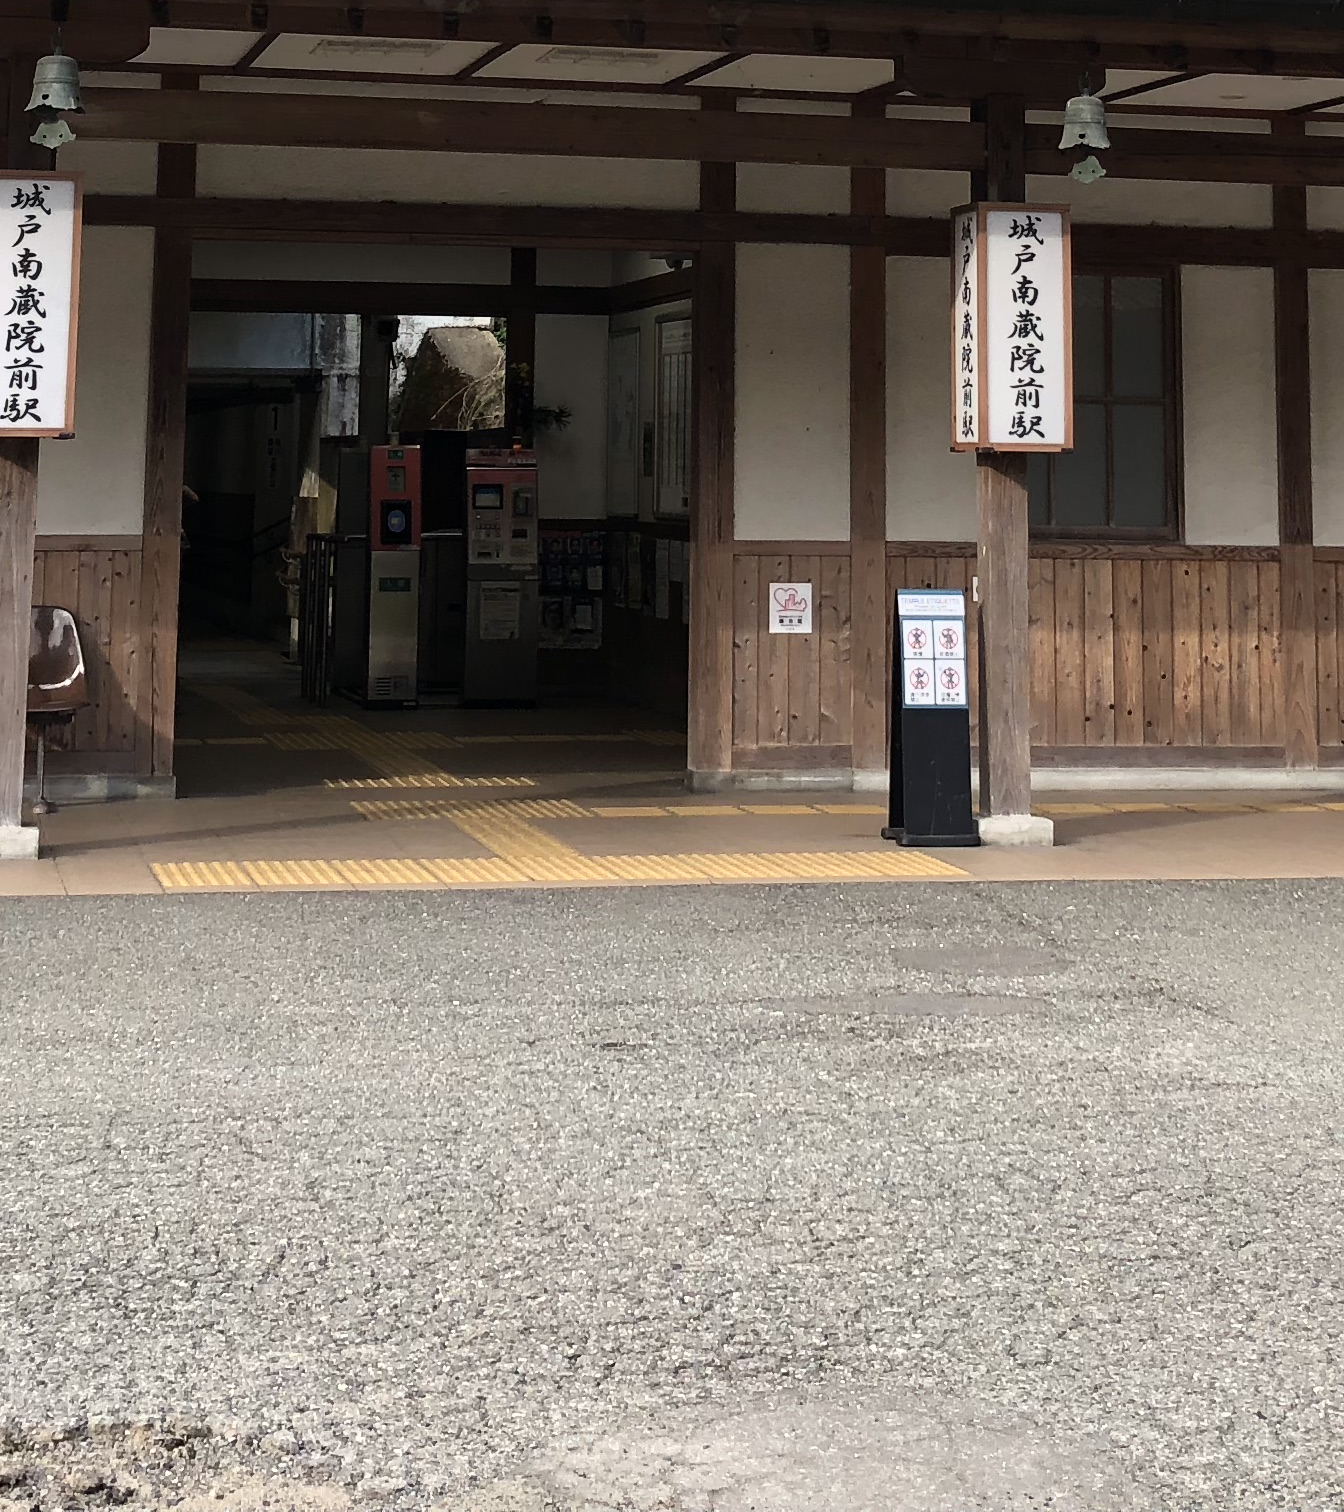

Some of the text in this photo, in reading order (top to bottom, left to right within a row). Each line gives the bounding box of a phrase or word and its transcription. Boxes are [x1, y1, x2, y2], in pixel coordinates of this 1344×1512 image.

[0, 183, 52, 423] 城戸南蔵院前駅
[961, 217, 975, 439] 城戸南蔵院前駅
[1007, 215, 1046, 439] 城戸南蔵院前駅
